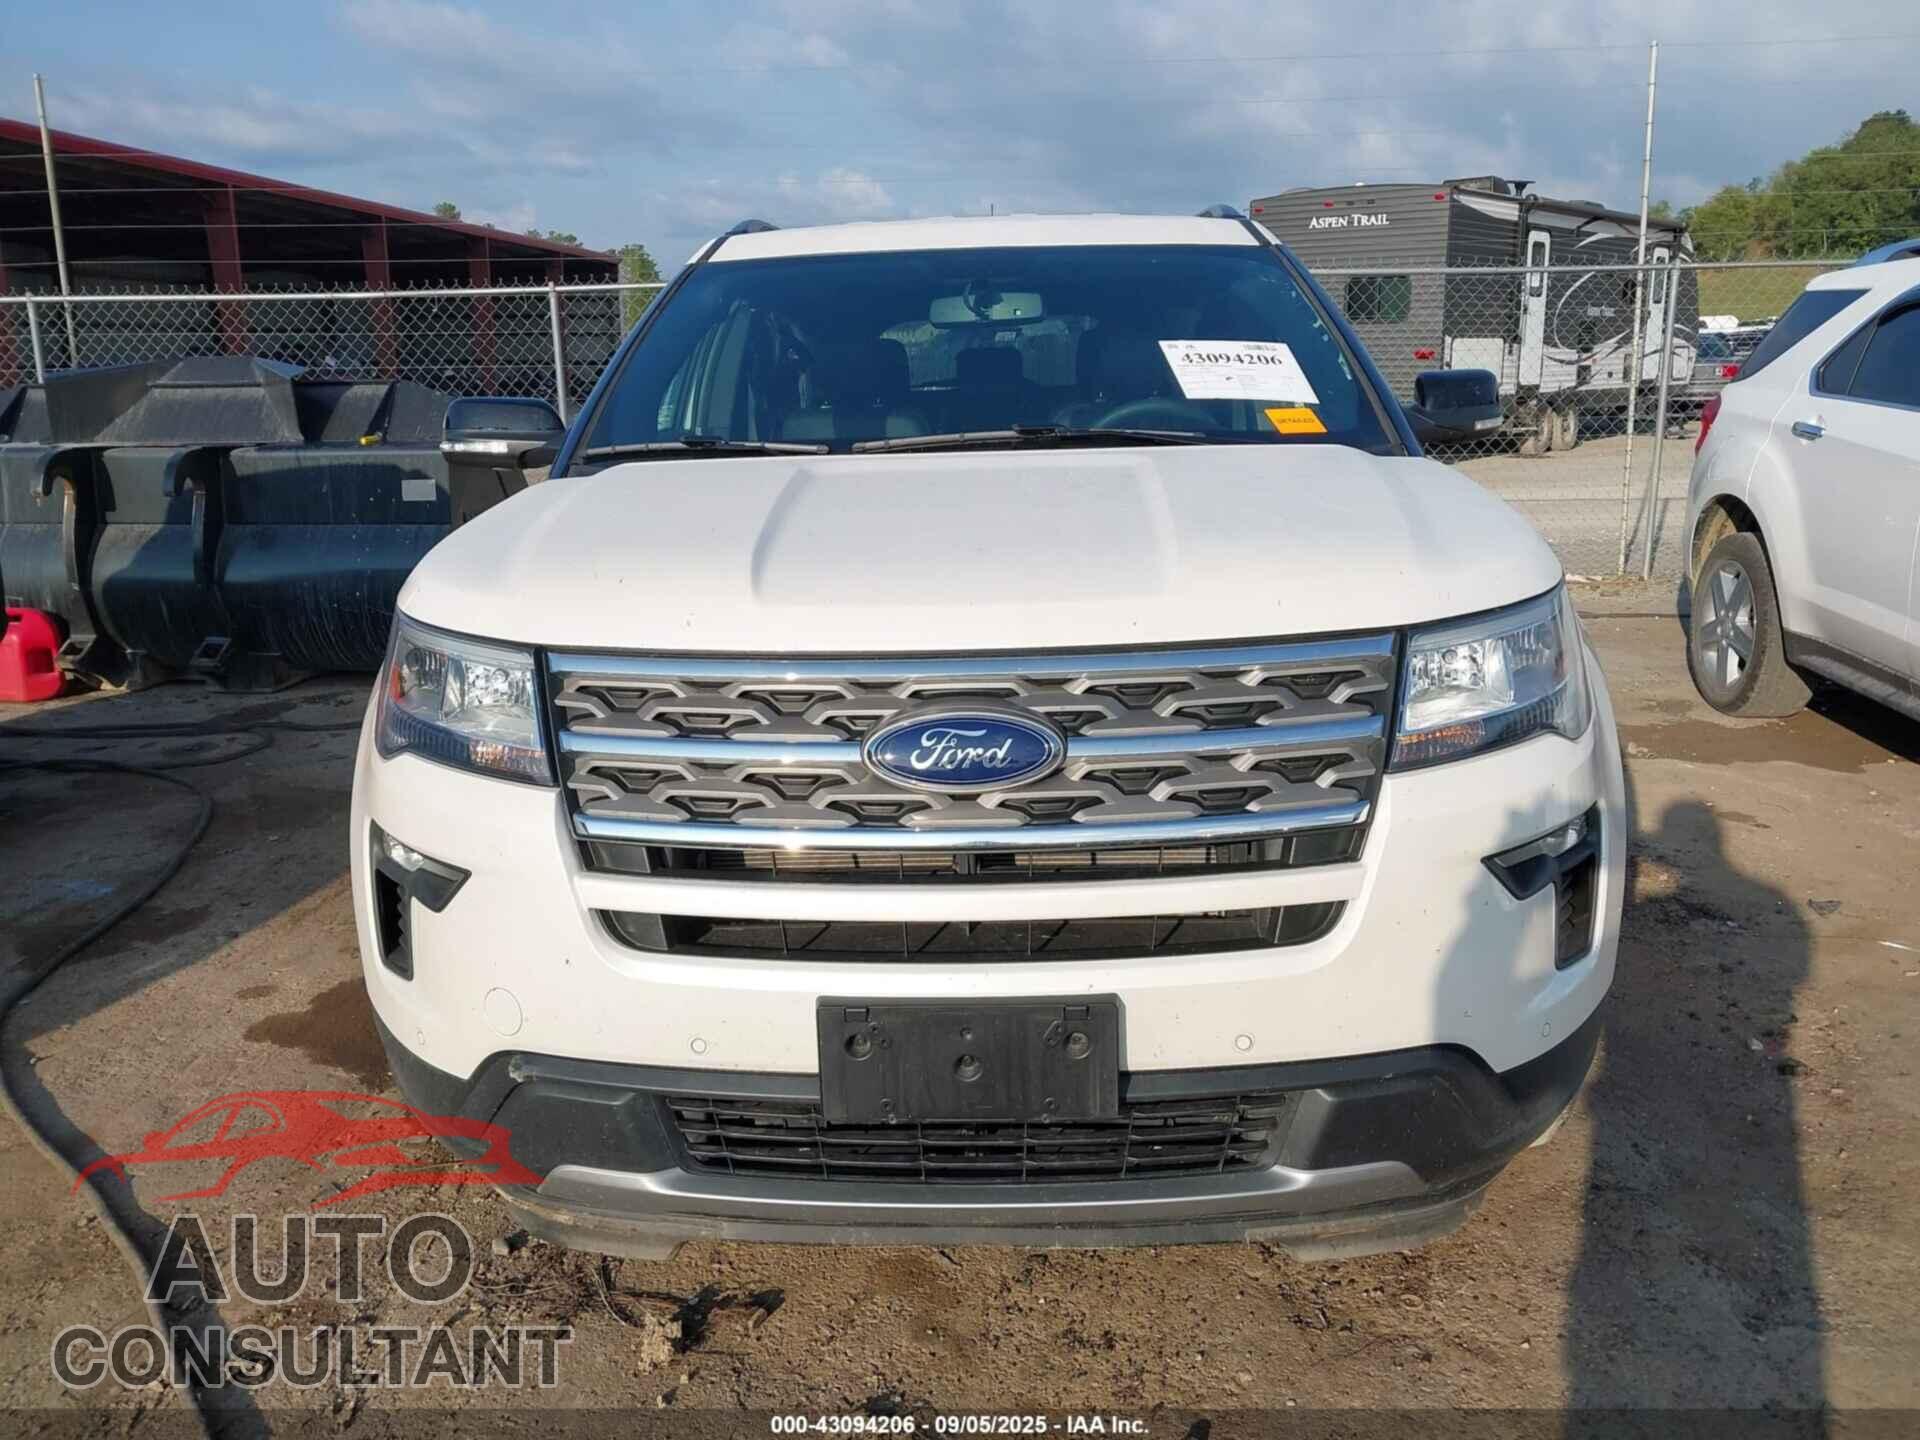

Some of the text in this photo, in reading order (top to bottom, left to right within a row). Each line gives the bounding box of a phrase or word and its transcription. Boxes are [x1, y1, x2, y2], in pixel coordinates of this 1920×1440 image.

[1308, 213, 1390, 230] ASPEN TRAIL
[1181, 352, 1283, 366] 43094206
[909, 727, 1014, 770] Ford
